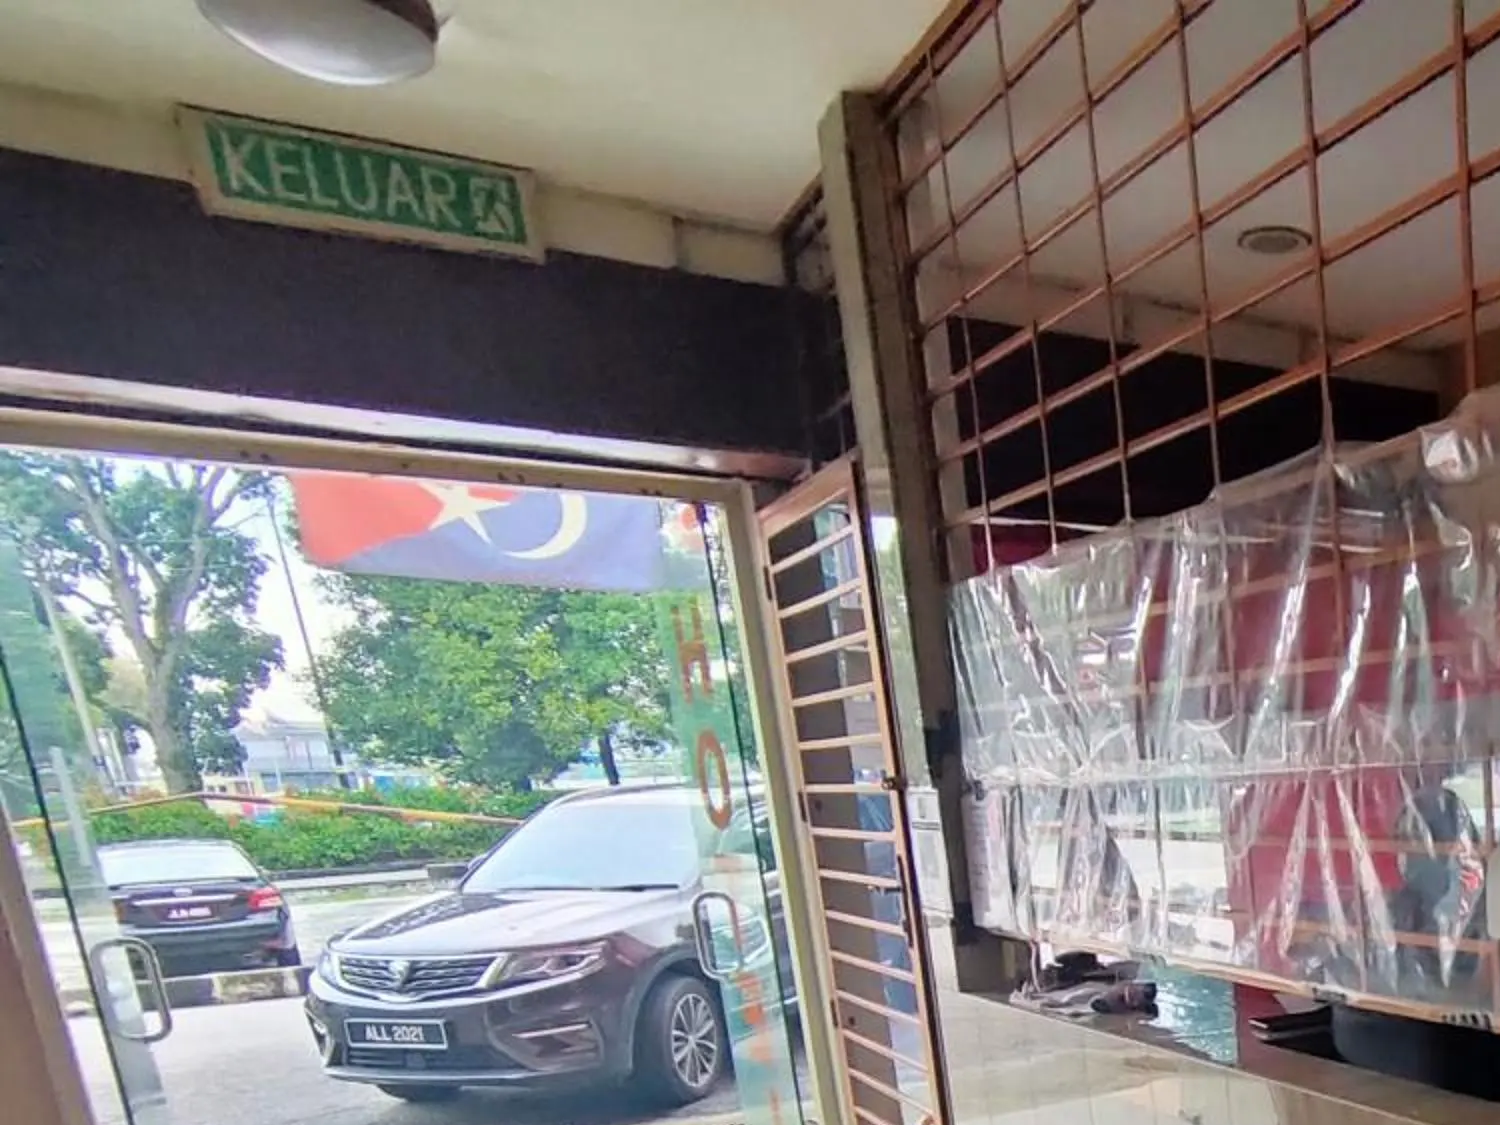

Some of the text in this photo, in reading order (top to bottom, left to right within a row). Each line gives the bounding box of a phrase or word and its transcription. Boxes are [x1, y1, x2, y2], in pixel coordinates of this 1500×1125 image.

[219, 126, 463, 228] KELUAR
[364, 1023, 425, 1042] ALL 2021
